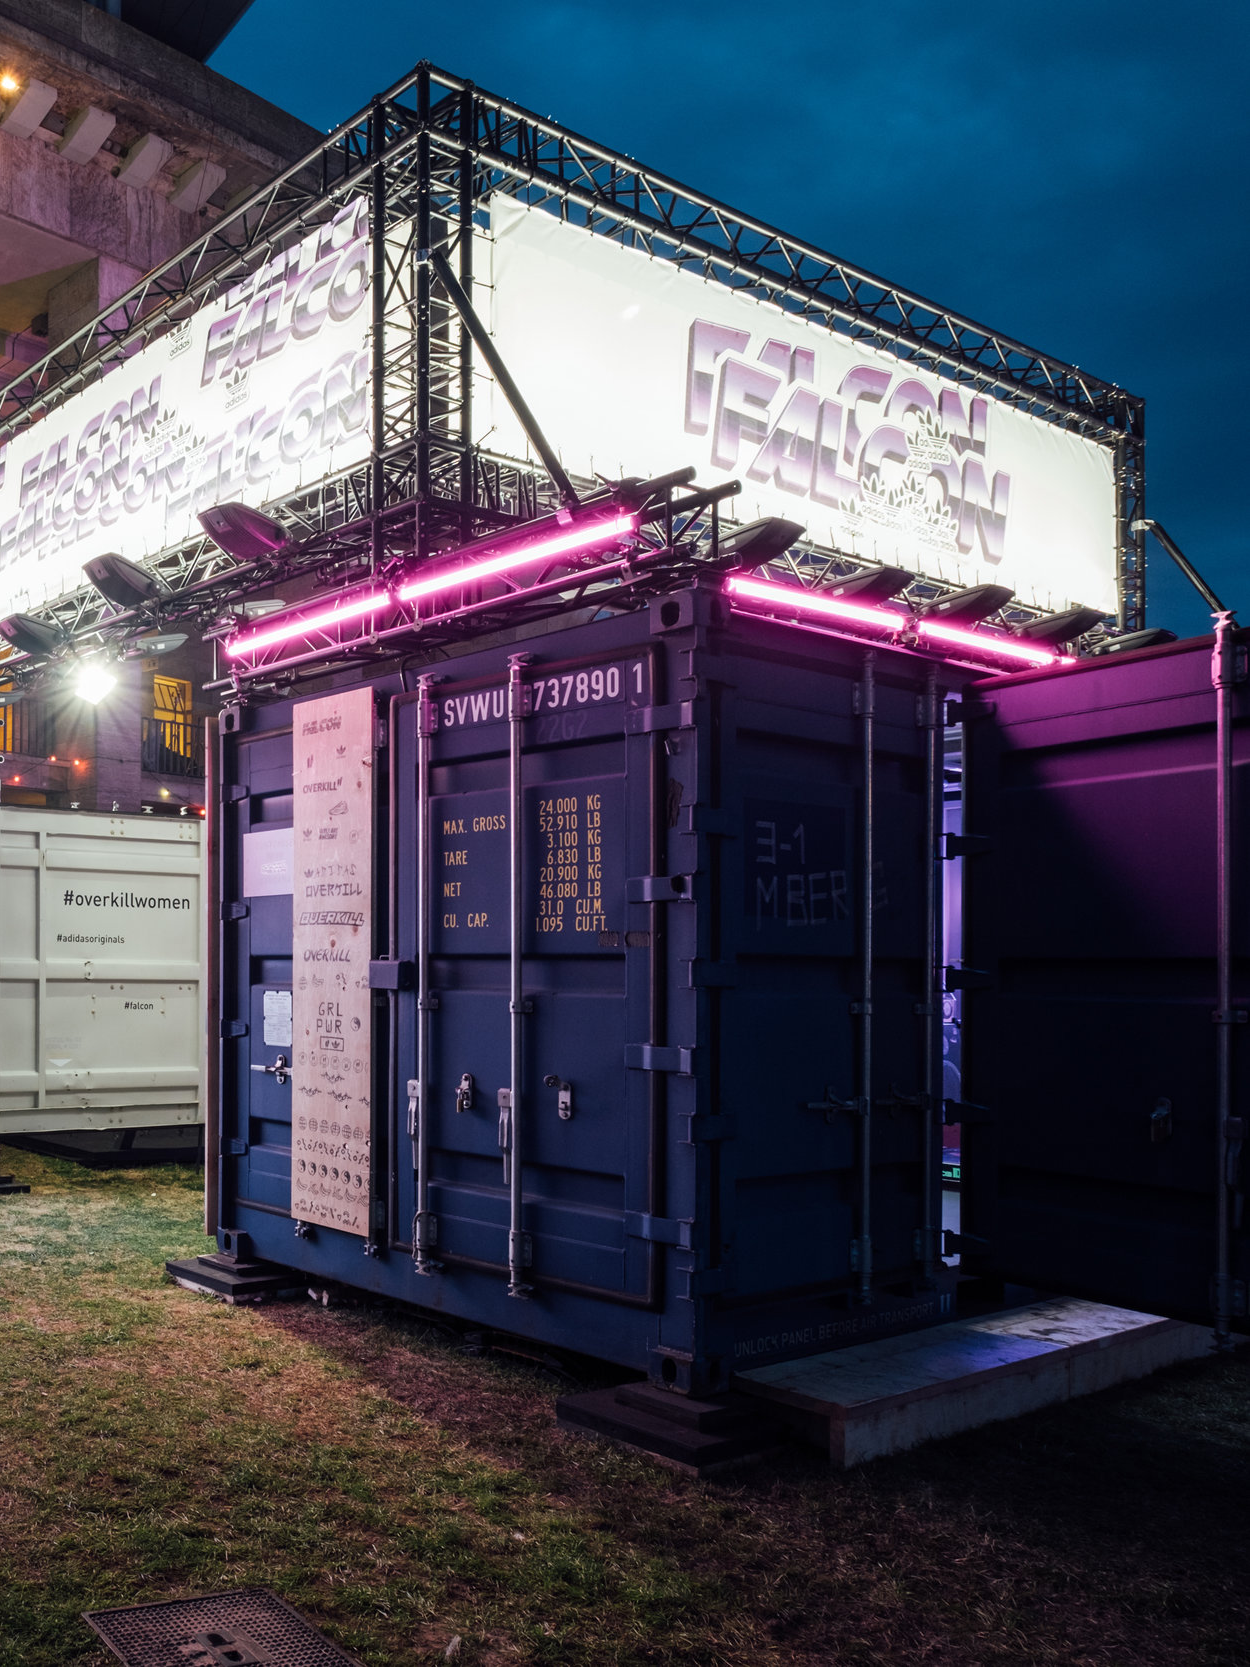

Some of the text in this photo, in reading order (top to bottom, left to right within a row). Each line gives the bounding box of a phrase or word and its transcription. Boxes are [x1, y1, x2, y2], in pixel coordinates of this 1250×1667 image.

[224, 391, 248, 409] adidas
[444, 662, 643, 727] SVWU 737890 1
[587, 794, 601, 811] KG
[443, 815, 507, 836] MAX. GROSS
[587, 812, 601, 829] LB
[587, 829, 601, 845] KG
[444, 850, 468, 866] TARE
[587, 847, 601, 863] LB
[587, 864, 602, 880] KG
[443, 882, 461, 897] NET
[587, 881, 601, 897] LB
[63, 889, 191, 910] #overkillwomen
[539, 900, 564, 916] 31.0
[443, 912, 489, 928] CU. CAP.
[56, 933, 125, 945] #adidasoriginals
[124, 1001, 154, 1010] #falcon
[318, 1001, 343, 1017] GRL
[316, 1018, 342, 1034] PWR
